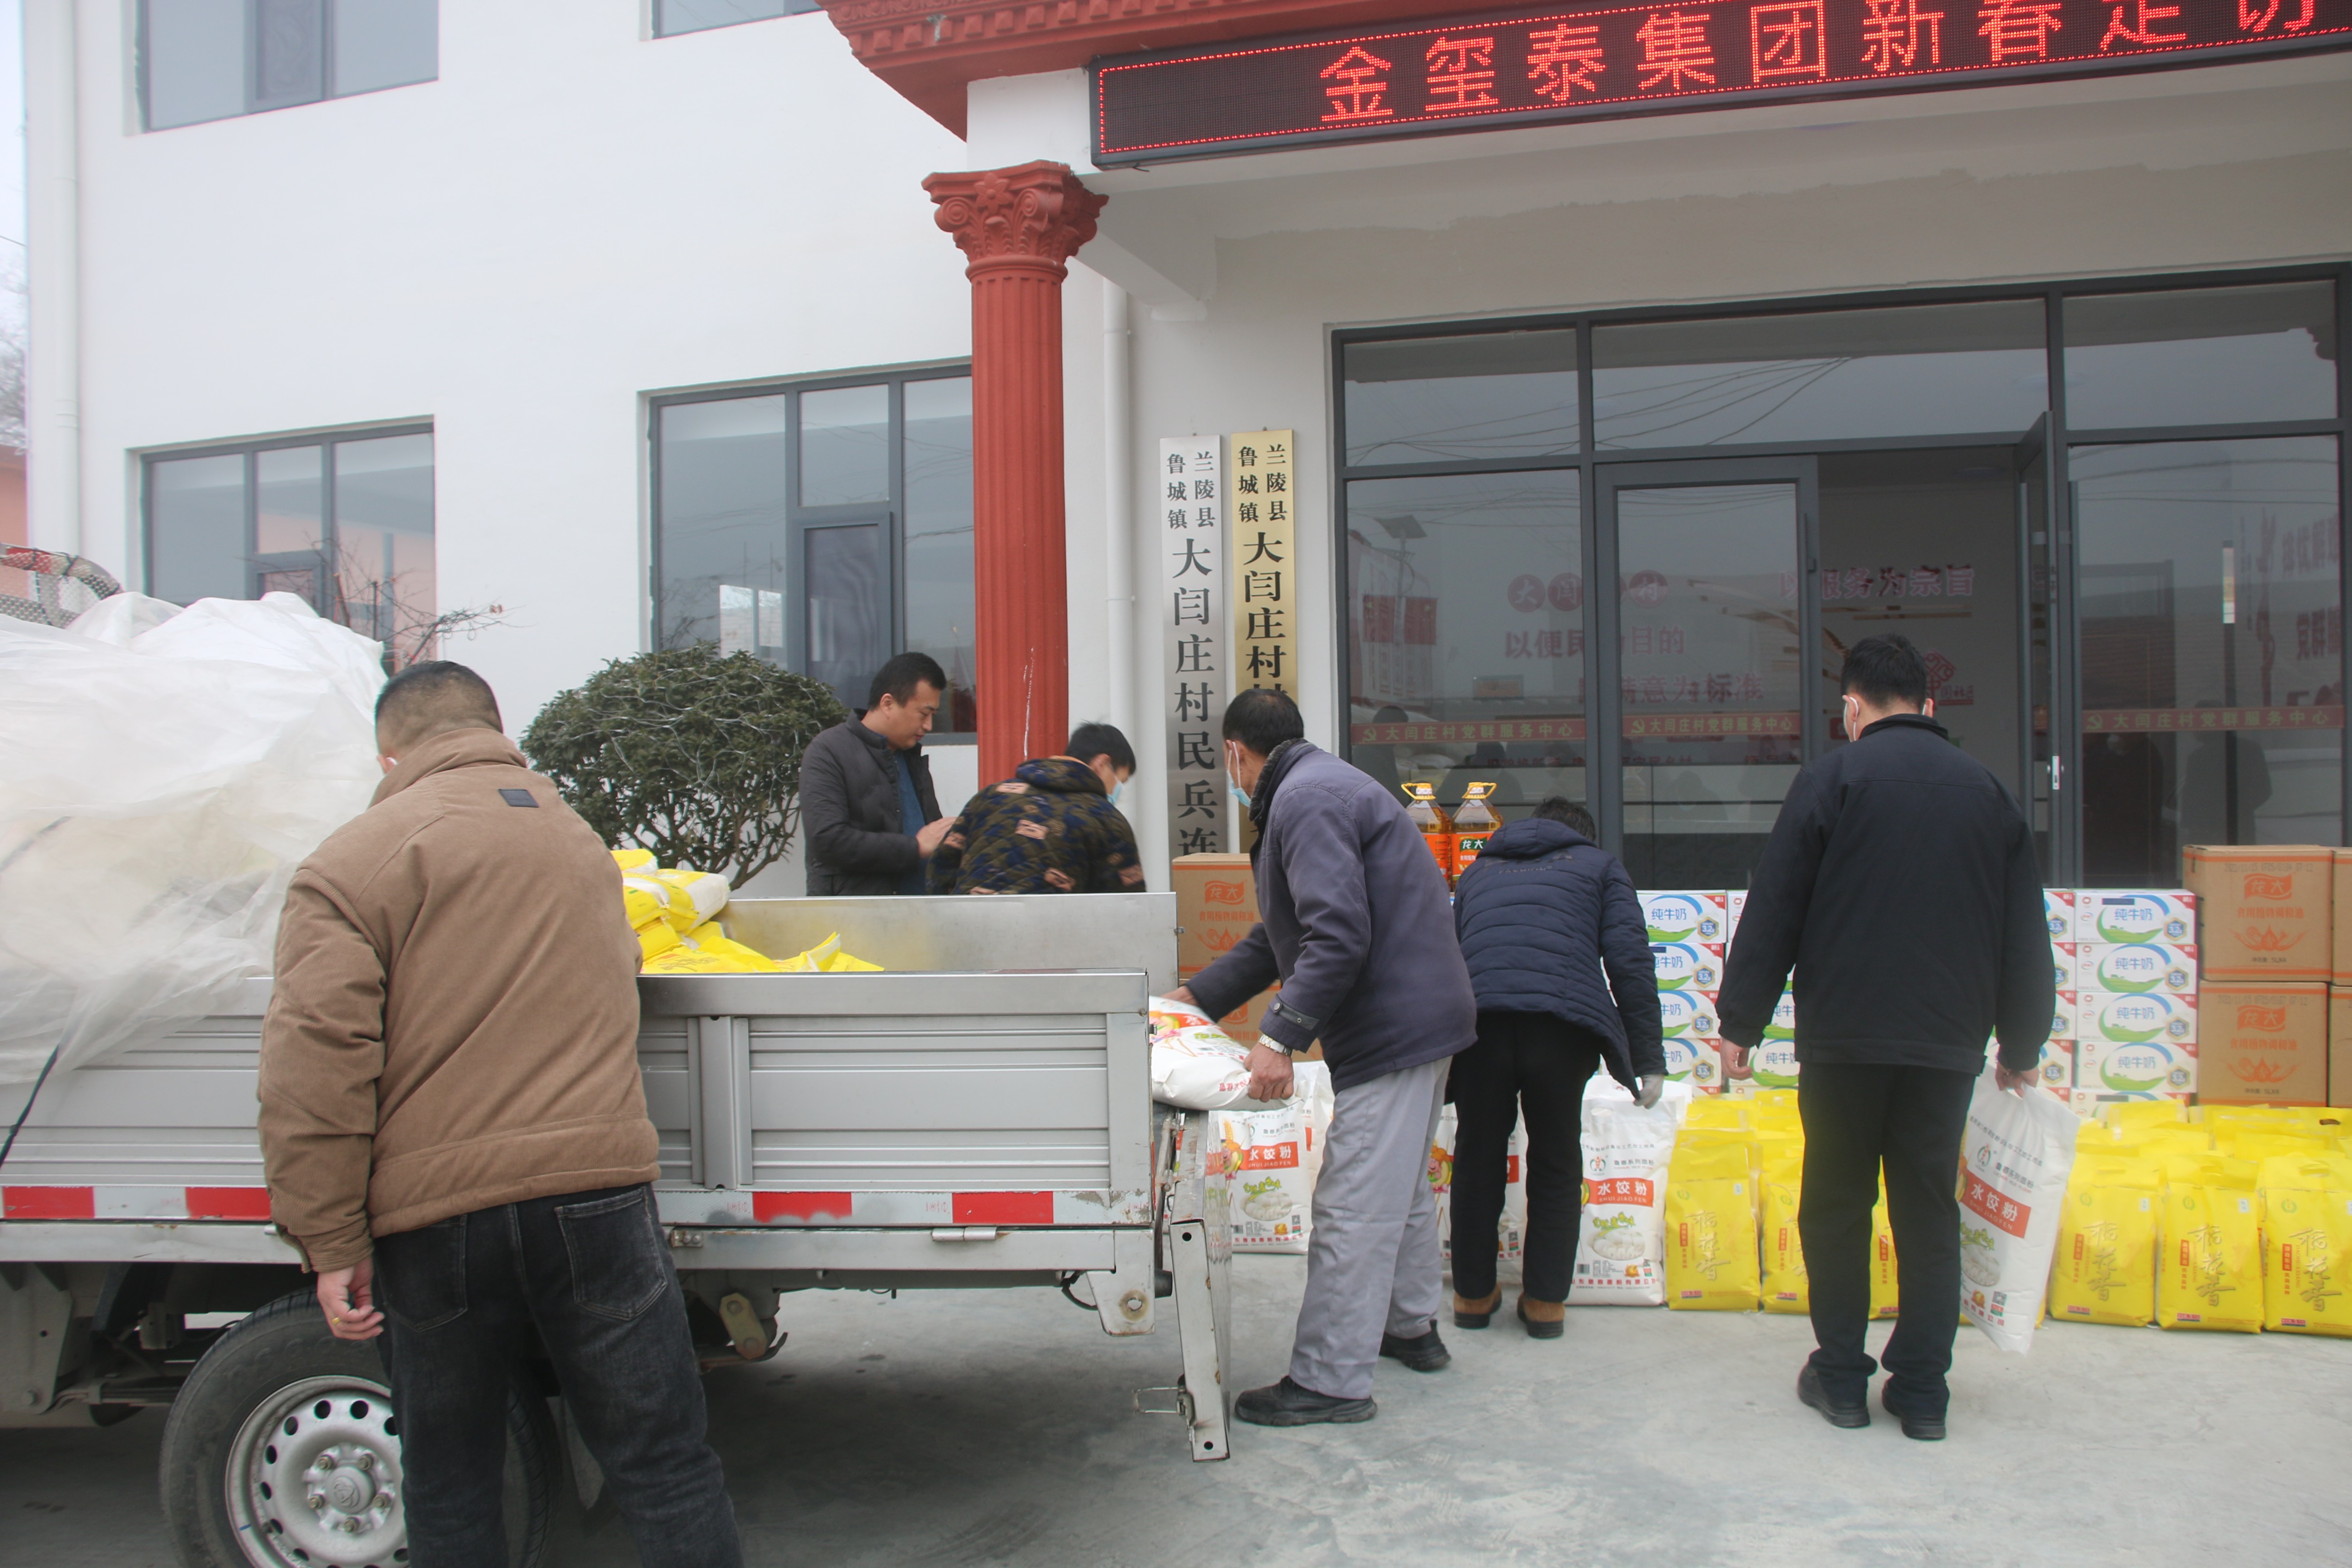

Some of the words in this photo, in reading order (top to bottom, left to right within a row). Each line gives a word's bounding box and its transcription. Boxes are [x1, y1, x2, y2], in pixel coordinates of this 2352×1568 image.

[1194, 451, 1216, 528] 兰陵县
[1238, 446, 1259, 523] 鲁城镇
[1266, 444, 1287, 521] 兰陵县
[1167, 454, 1187, 529] 鲁城镇
[1650, 716, 1793, 733] 大闫庄村党群服务中心
[2113, 710, 2328, 729] 大闫庄村党群服务中心
[1385, 722, 1573, 741] 大闫庄村党群服务中心
[2251, 880, 2284, 893] 龙大
[1651, 908, 1687, 921] 纯牛奶
[2114, 908, 2153, 921] 纯牛奶
[2115, 957, 2154, 971] 纯牛奶
[2117, 1007, 2155, 1020] 纯牛奶
[2244, 1012, 2278, 1025] 龙大
[2118, 1056, 2156, 1069] 纯牛奶
[1249, 1145, 1292, 1161] 水饺粉
[1597, 1181, 1647, 1195] 水饺粉
[1971, 1183, 2018, 1222] 水饺粉
[2000, 1218, 2013, 1230] FEN
